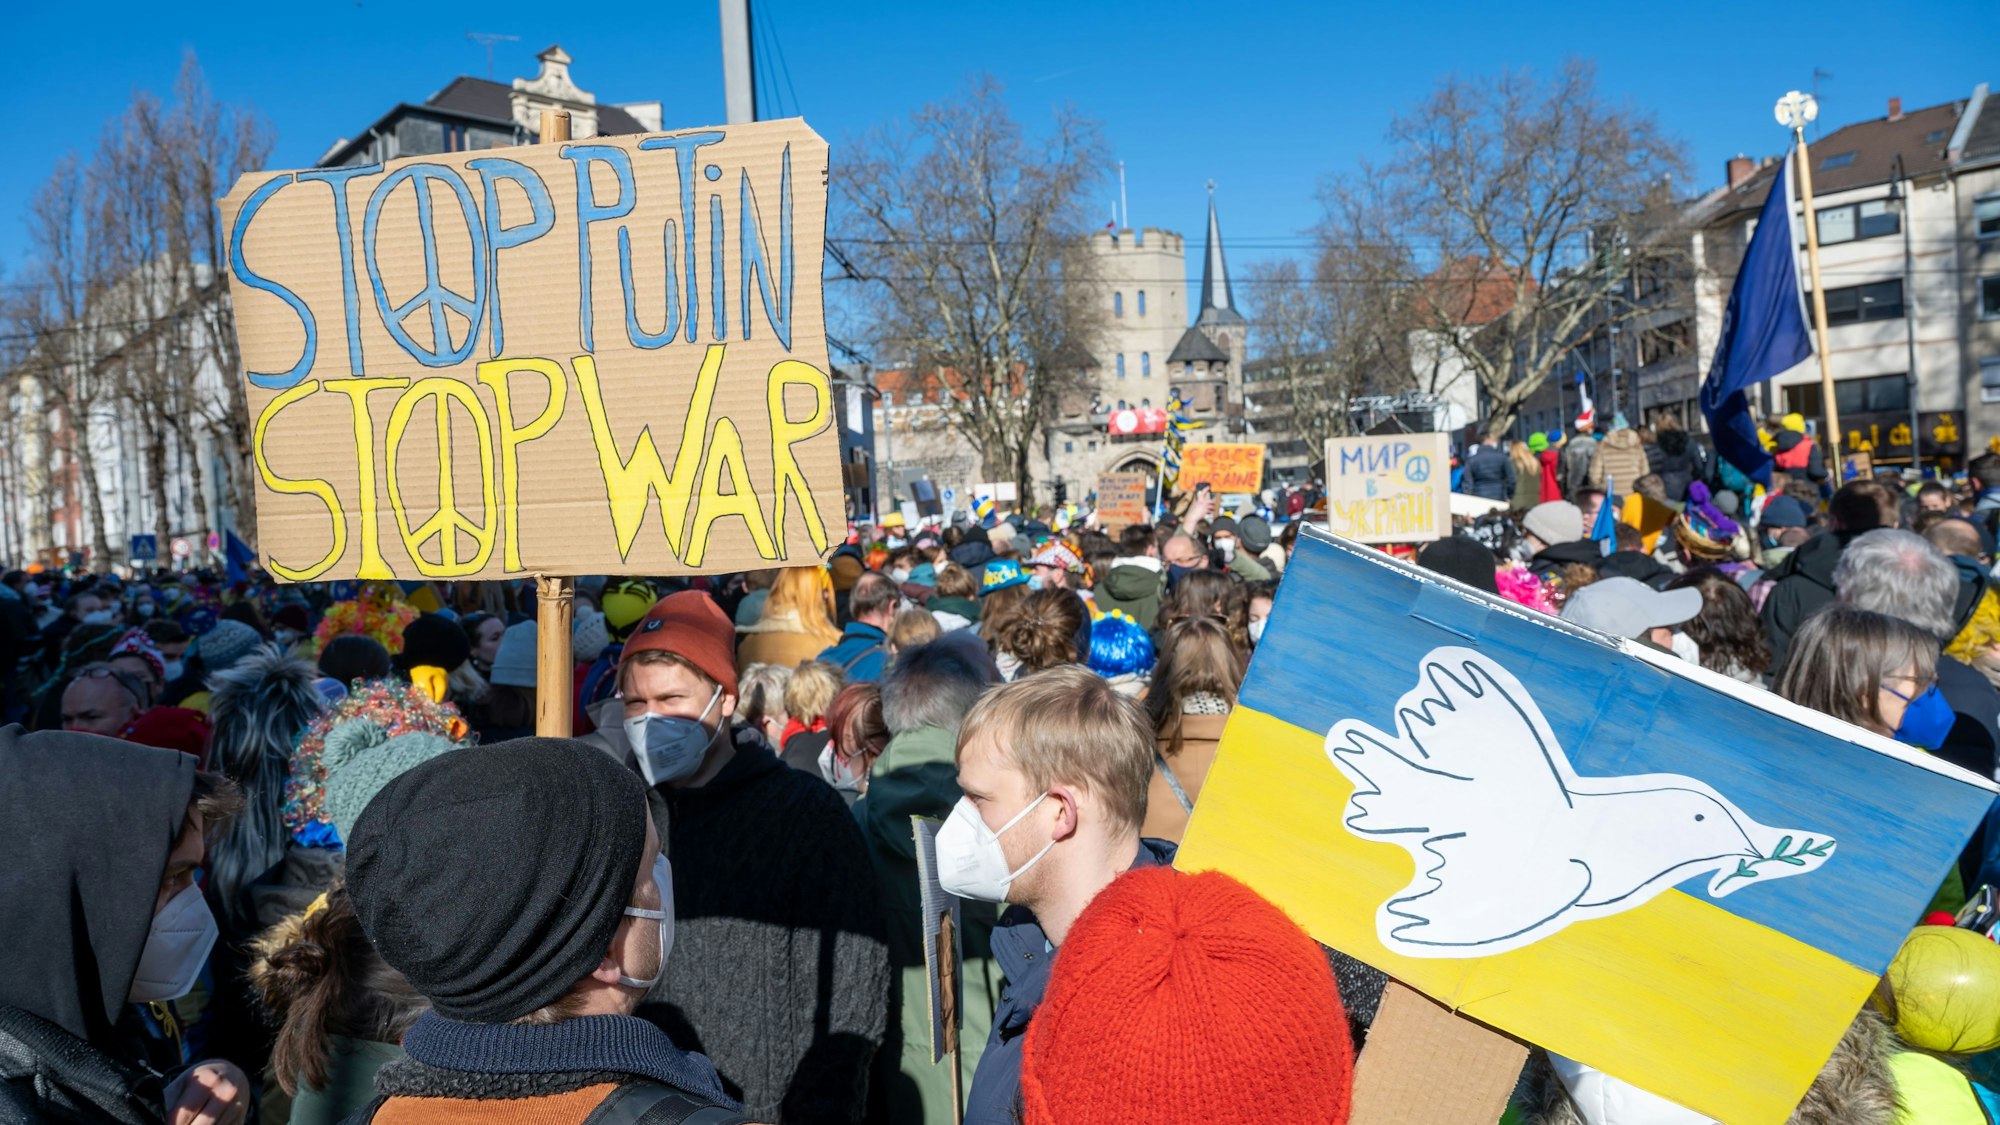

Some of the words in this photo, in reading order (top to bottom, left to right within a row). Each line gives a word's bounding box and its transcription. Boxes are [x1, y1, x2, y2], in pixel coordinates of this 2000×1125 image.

[230, 158, 556, 388] STOP
[253, 357, 567, 582] STOP
[572, 345, 833, 567] WAR
[1183, 471, 1258, 490] UKRAINE
[1340, 441, 1411, 475] МИР
